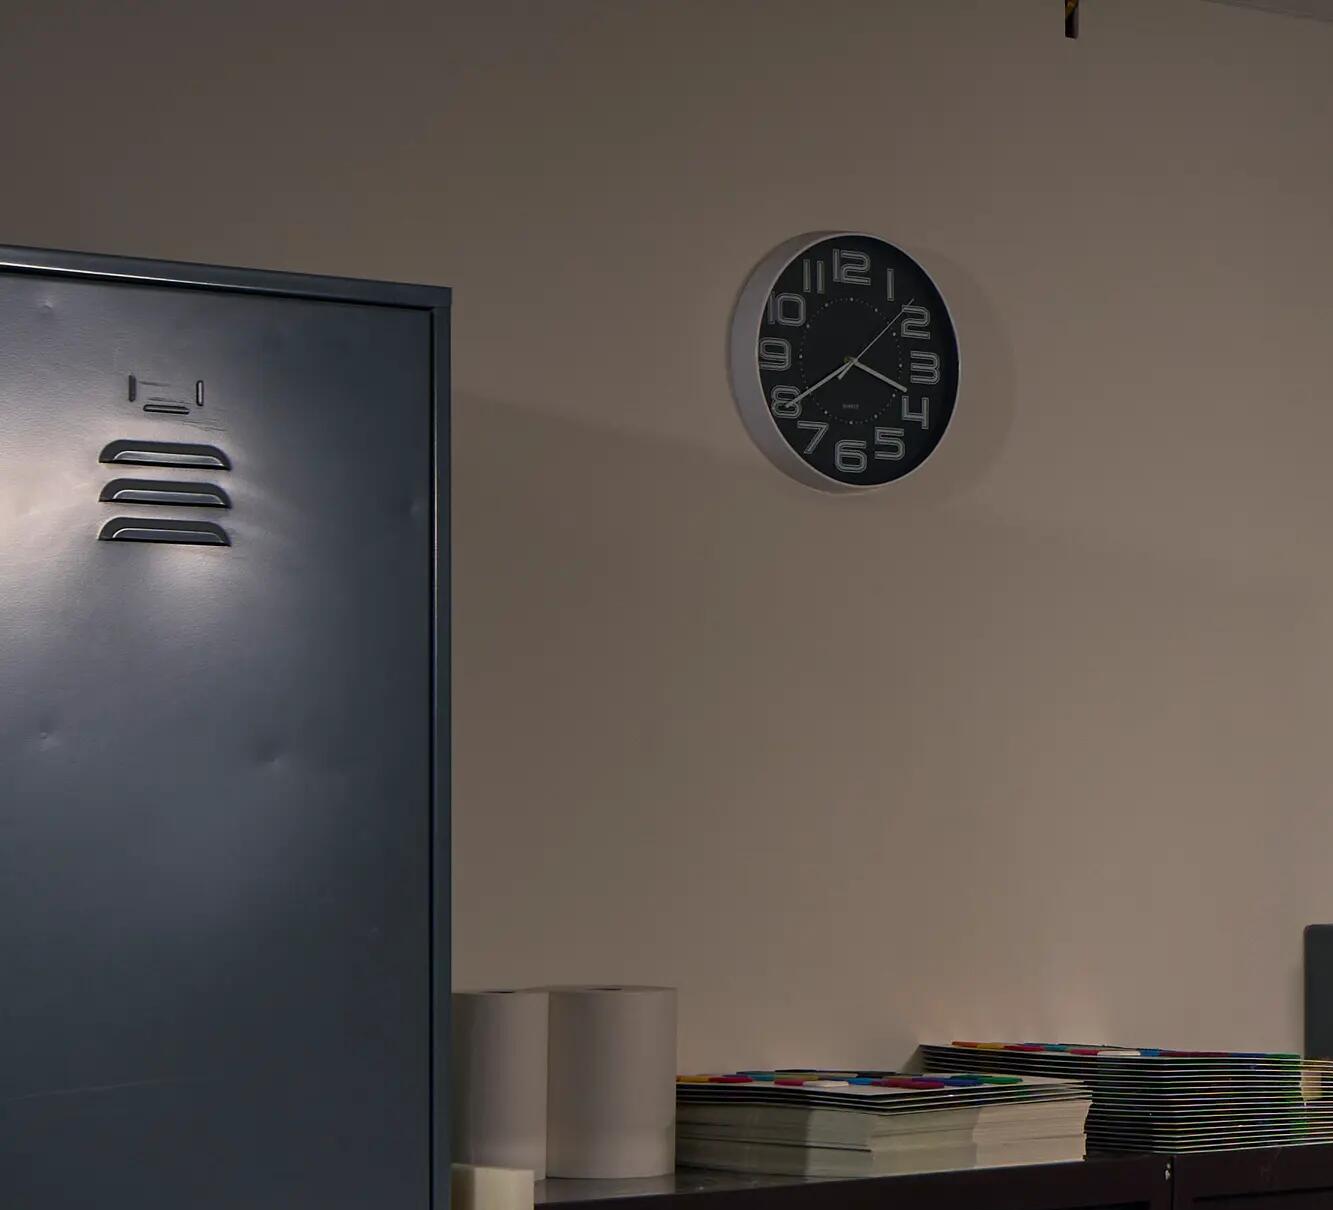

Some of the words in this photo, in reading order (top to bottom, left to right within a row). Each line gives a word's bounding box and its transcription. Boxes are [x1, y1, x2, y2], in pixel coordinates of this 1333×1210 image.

[803, 259, 824, 293] 11
[833, 249, 871, 285] 12
[886, 268, 895, 301] 1
[767, 291, 806, 326] 10
[901, 305, 931, 339] 2
[759, 337, 792, 371] 9
[910, 351, 940, 384] 3
[771, 385, 801, 419] 8
[902, 395, 930, 430] 4
[797, 420, 830, 454] 7
[874, 426, 906, 460] 5
[834, 440, 868, 473] 6
